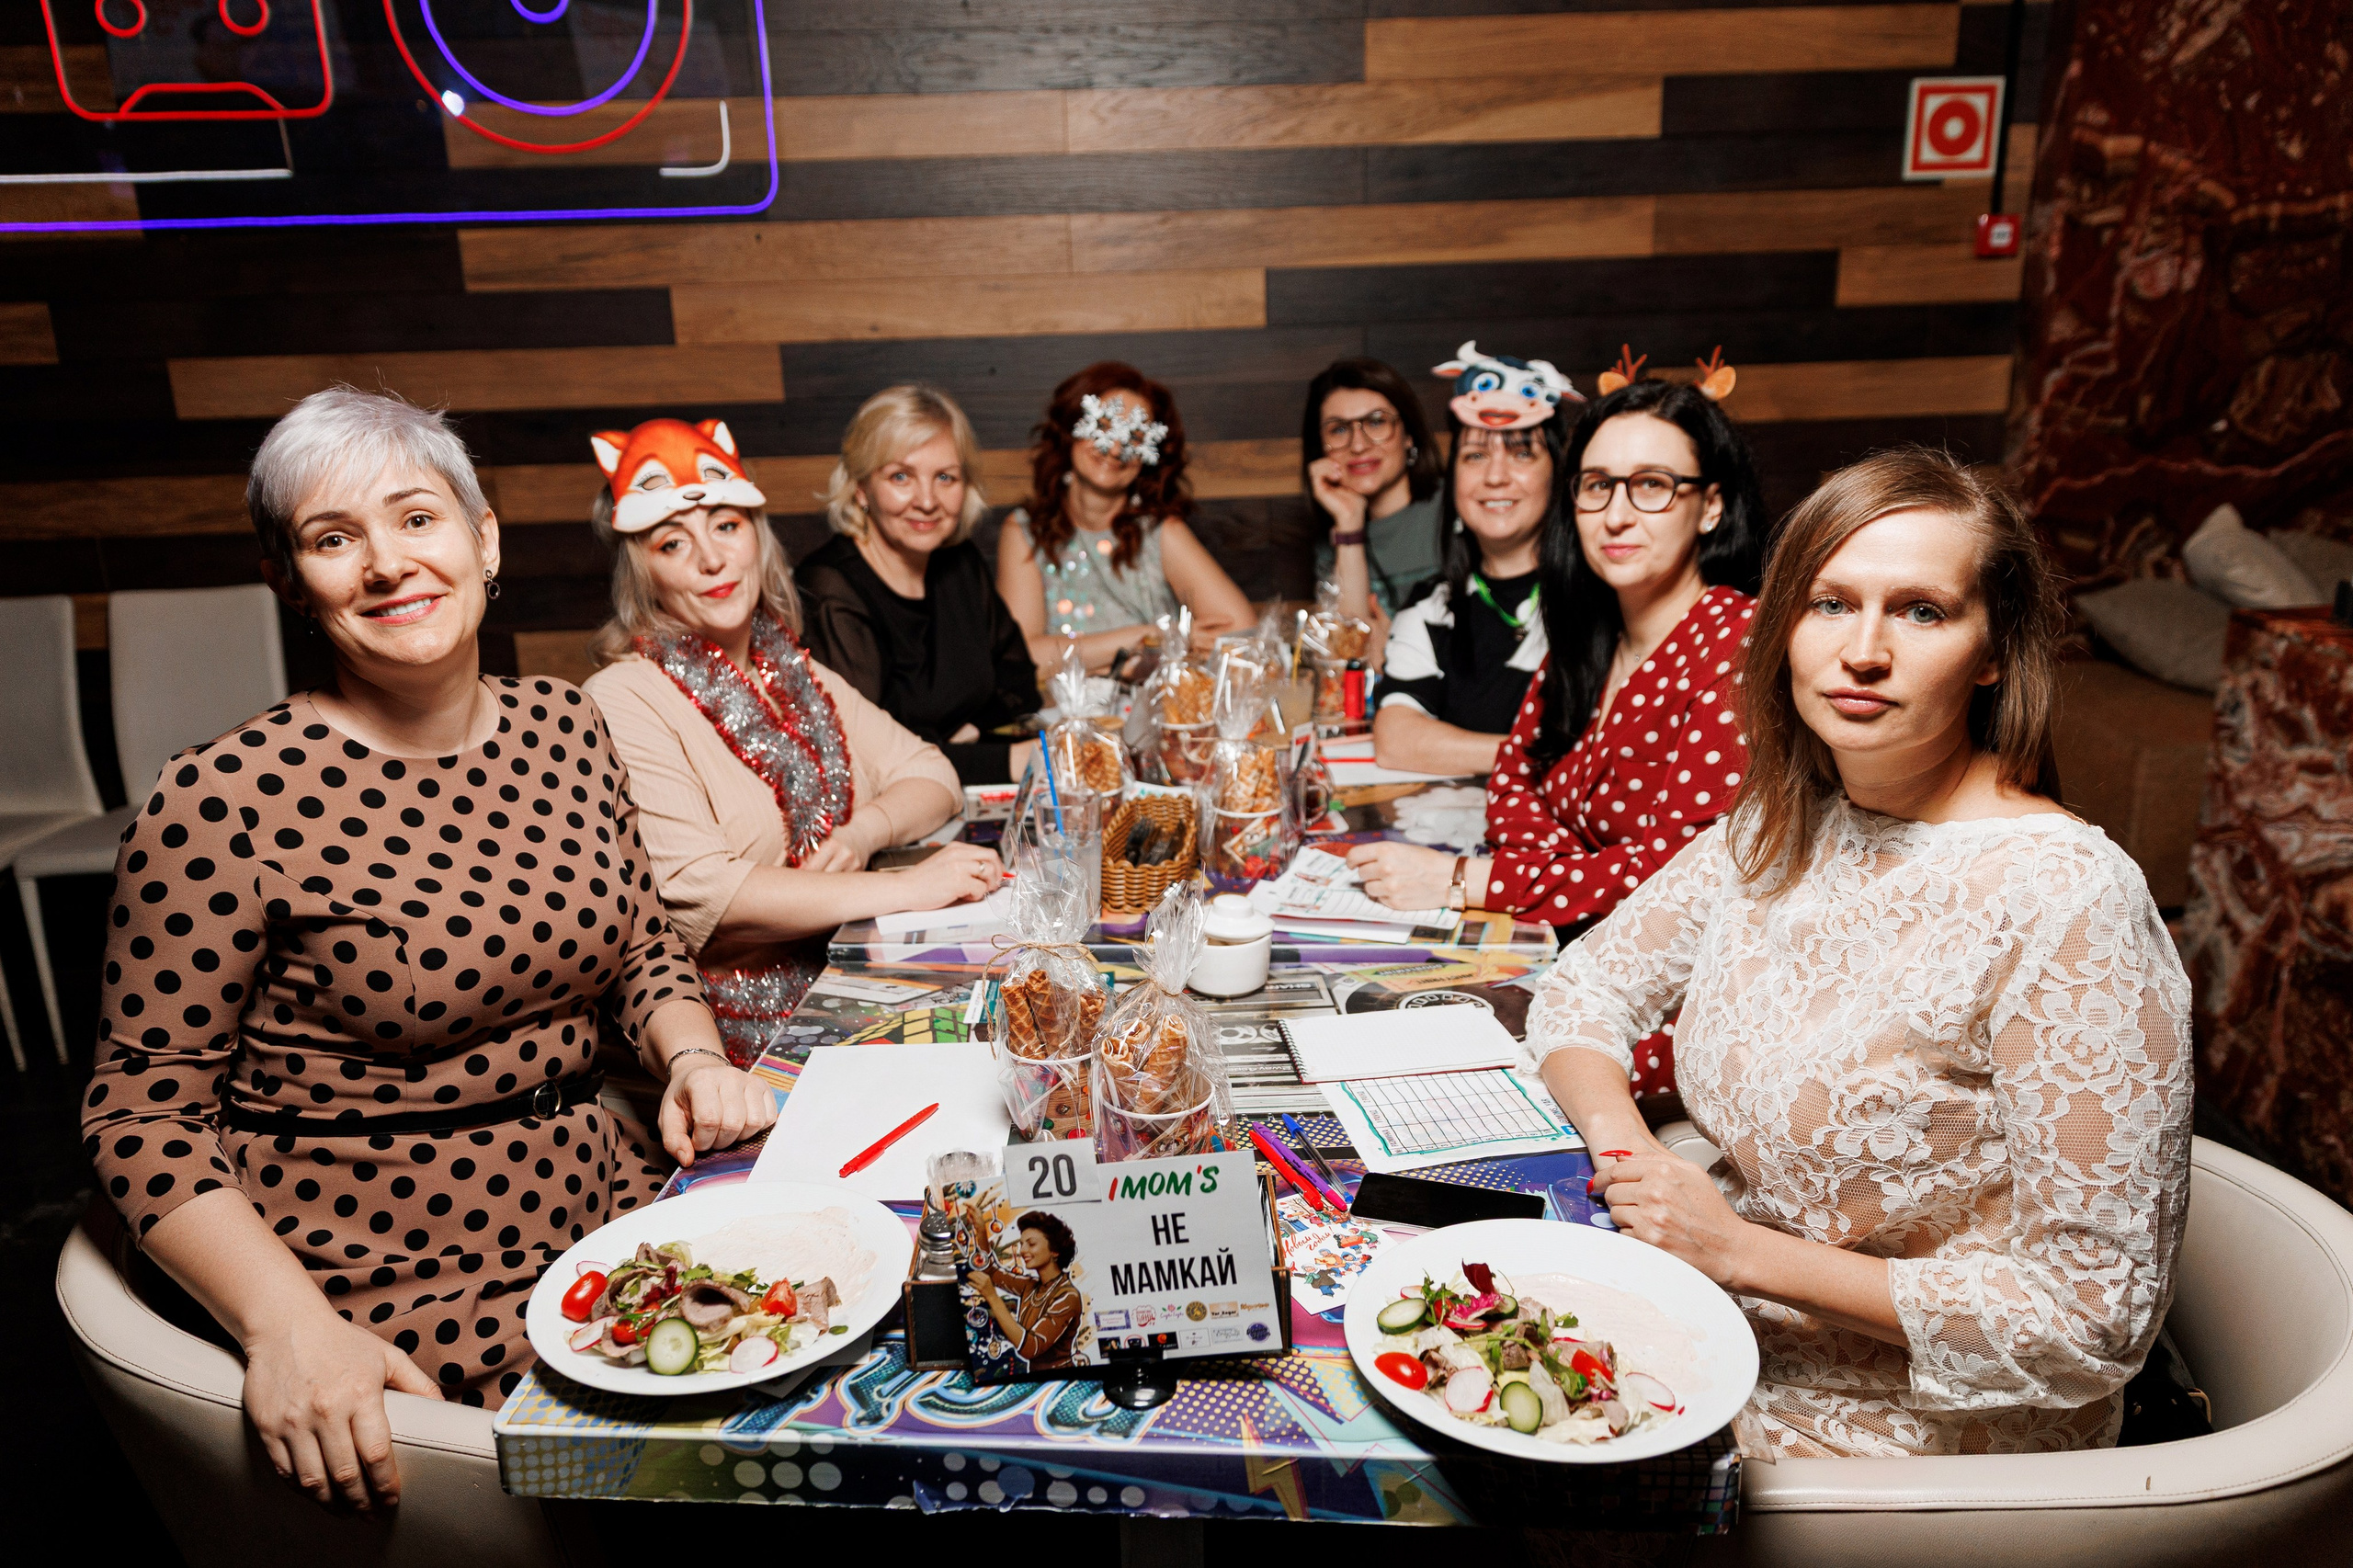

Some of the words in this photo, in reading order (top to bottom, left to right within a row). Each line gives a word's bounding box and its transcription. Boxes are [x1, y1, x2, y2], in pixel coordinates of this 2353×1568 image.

[1028, 1153, 1077, 1199] 20
[1151, 1211, 1190, 1246] НЕ
[1110, 1246, 1238, 1297] МАМКАЙ
